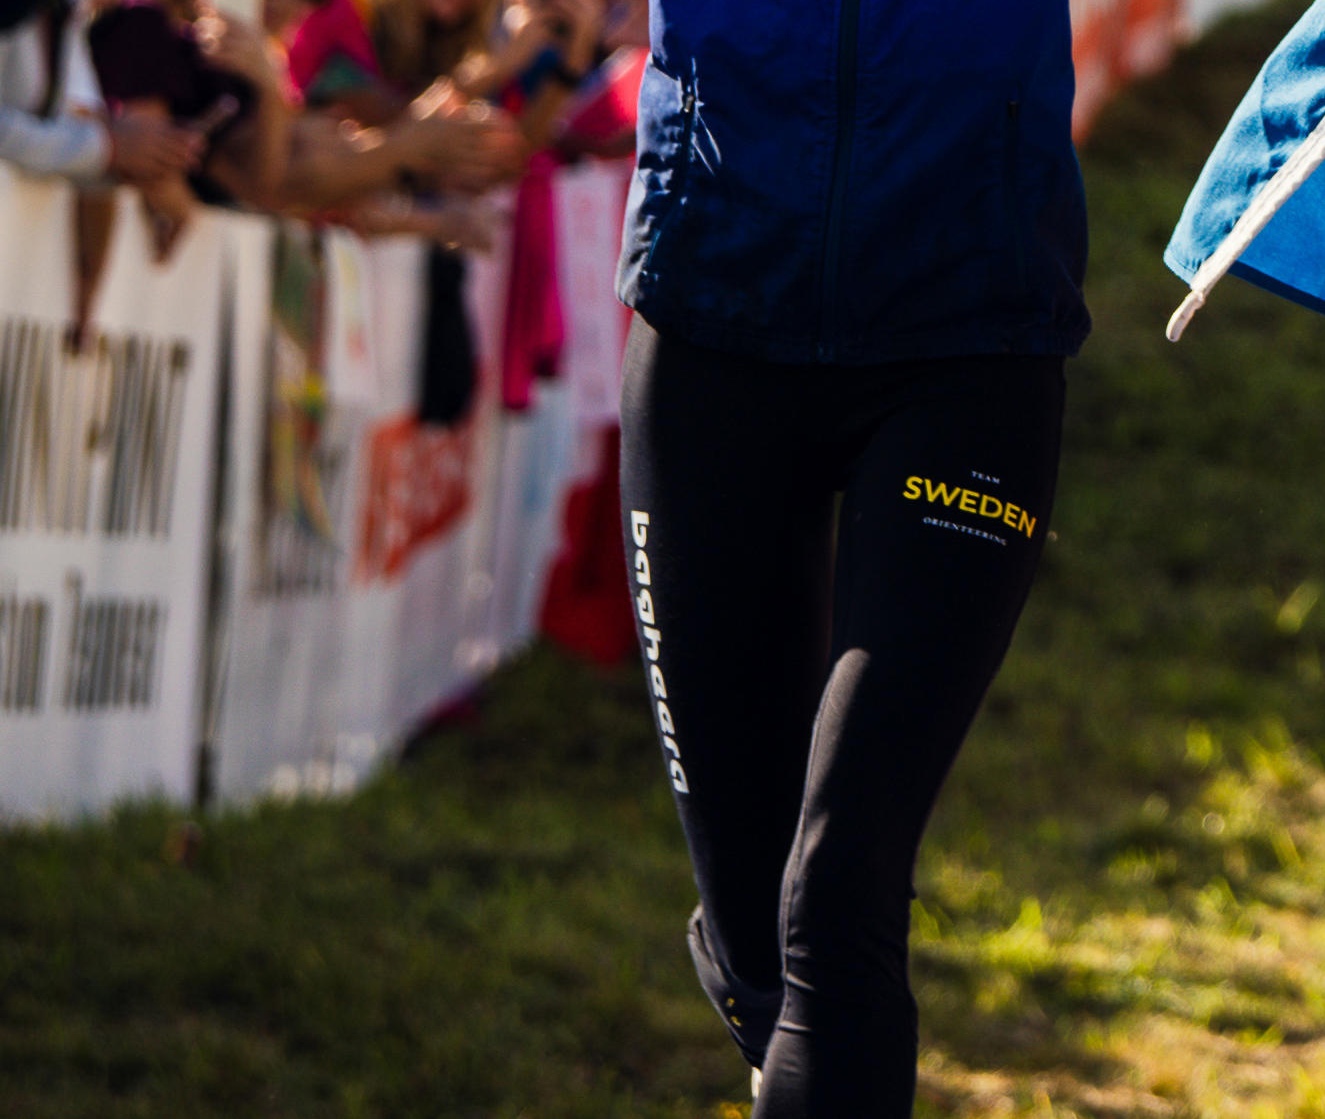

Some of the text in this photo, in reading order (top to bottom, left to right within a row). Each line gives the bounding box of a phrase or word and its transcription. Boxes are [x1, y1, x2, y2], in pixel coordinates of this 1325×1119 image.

[971, 470, 1000, 484] TEAM
[902, 476, 1037, 539] SWEDEN
[922, 516, 1007, 546] ORIENTEERING
[630, 510, 690, 794] bagheera
